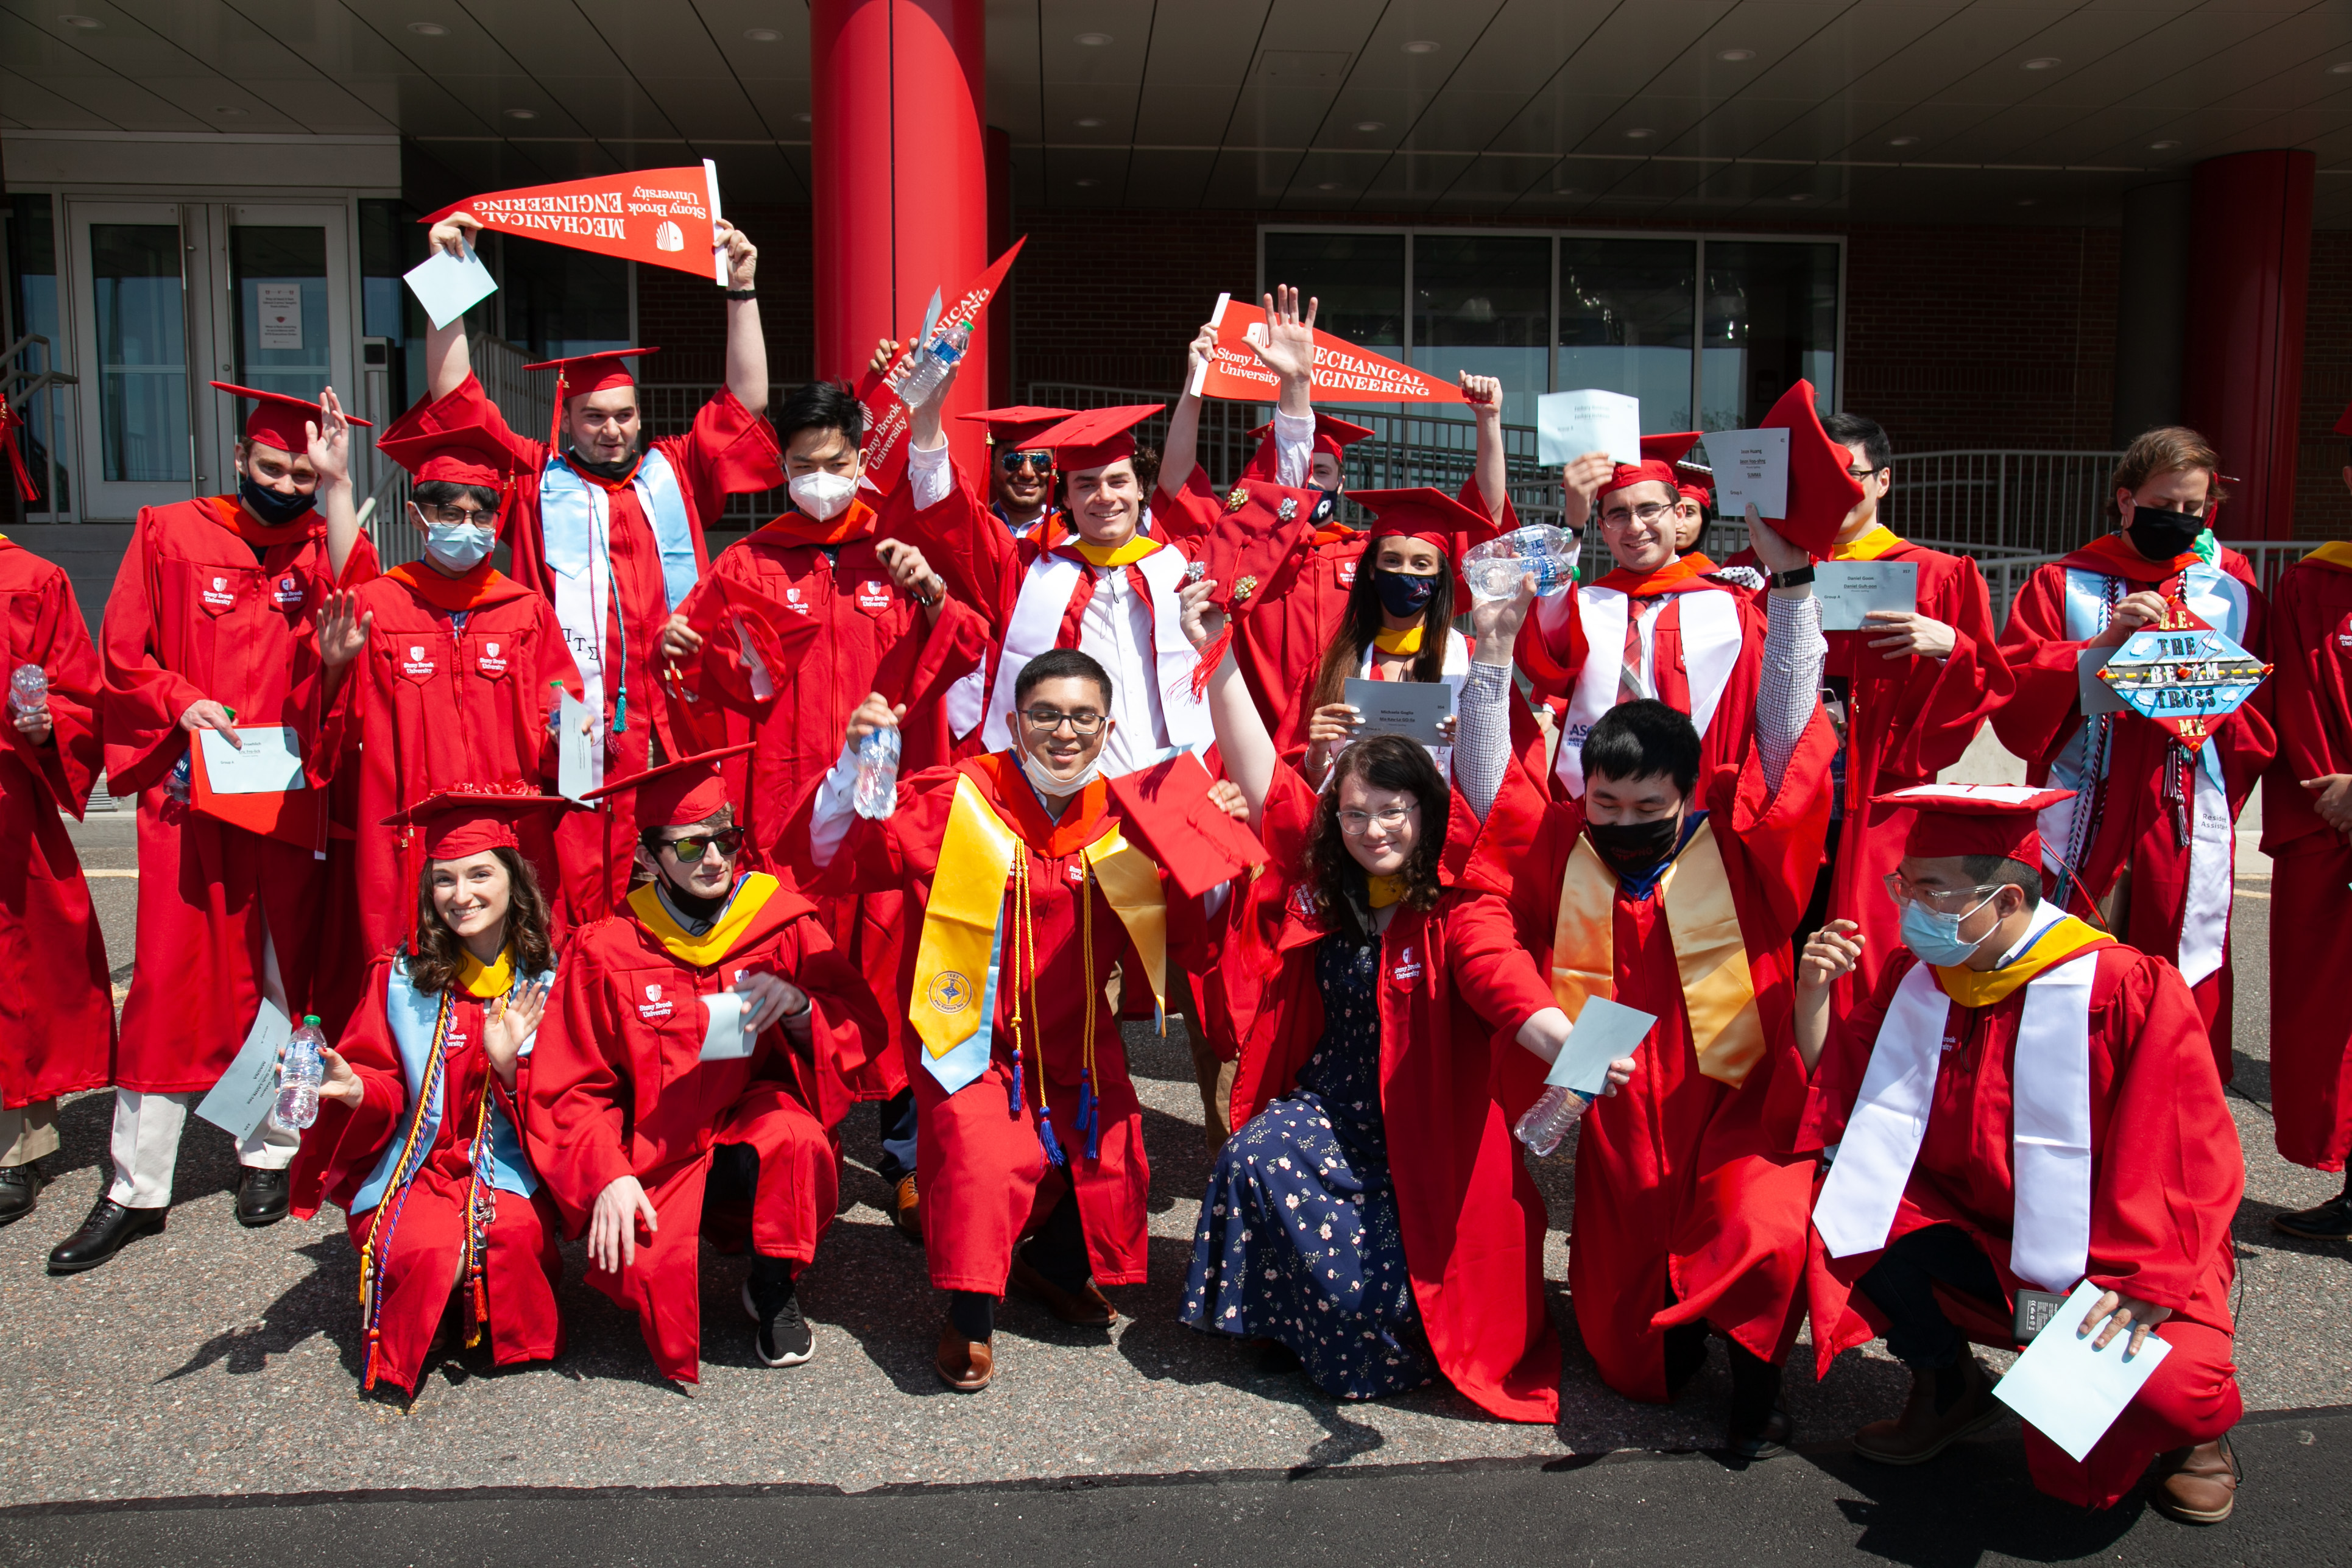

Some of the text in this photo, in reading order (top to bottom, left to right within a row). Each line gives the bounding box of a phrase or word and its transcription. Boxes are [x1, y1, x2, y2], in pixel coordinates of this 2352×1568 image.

[473, 192, 624, 213] ENGINEERING
[632, 186, 699, 205] University
[627, 202, 707, 219] Stony Brook
[481, 211, 626, 239] MECHANICAL
[1217, 347, 1252, 367] Stony
[1220, 361, 1281, 387] University
[1310, 369, 1430, 396] NGINEERING
[875, 402, 902, 439] Brook
[869, 416, 908, 470] University
[203, 590, 218, 599] Stony
[205, 596, 231, 606] University
[2157, 636, 2196, 655] THE
[2155, 689, 2216, 708] TRUSS
[2178, 719, 2206, 737] ME
[1296, 888, 1308, 914] University
[1301, 884, 1316, 915] Stony Brook
[1394, 962, 1421, 974] Stony Brook
[1396, 970, 1420, 980] University
[643, 1008, 671, 1018] University
[655, 1000, 673, 1009] Brook
[253, 1061, 266, 1080] MAGNA
